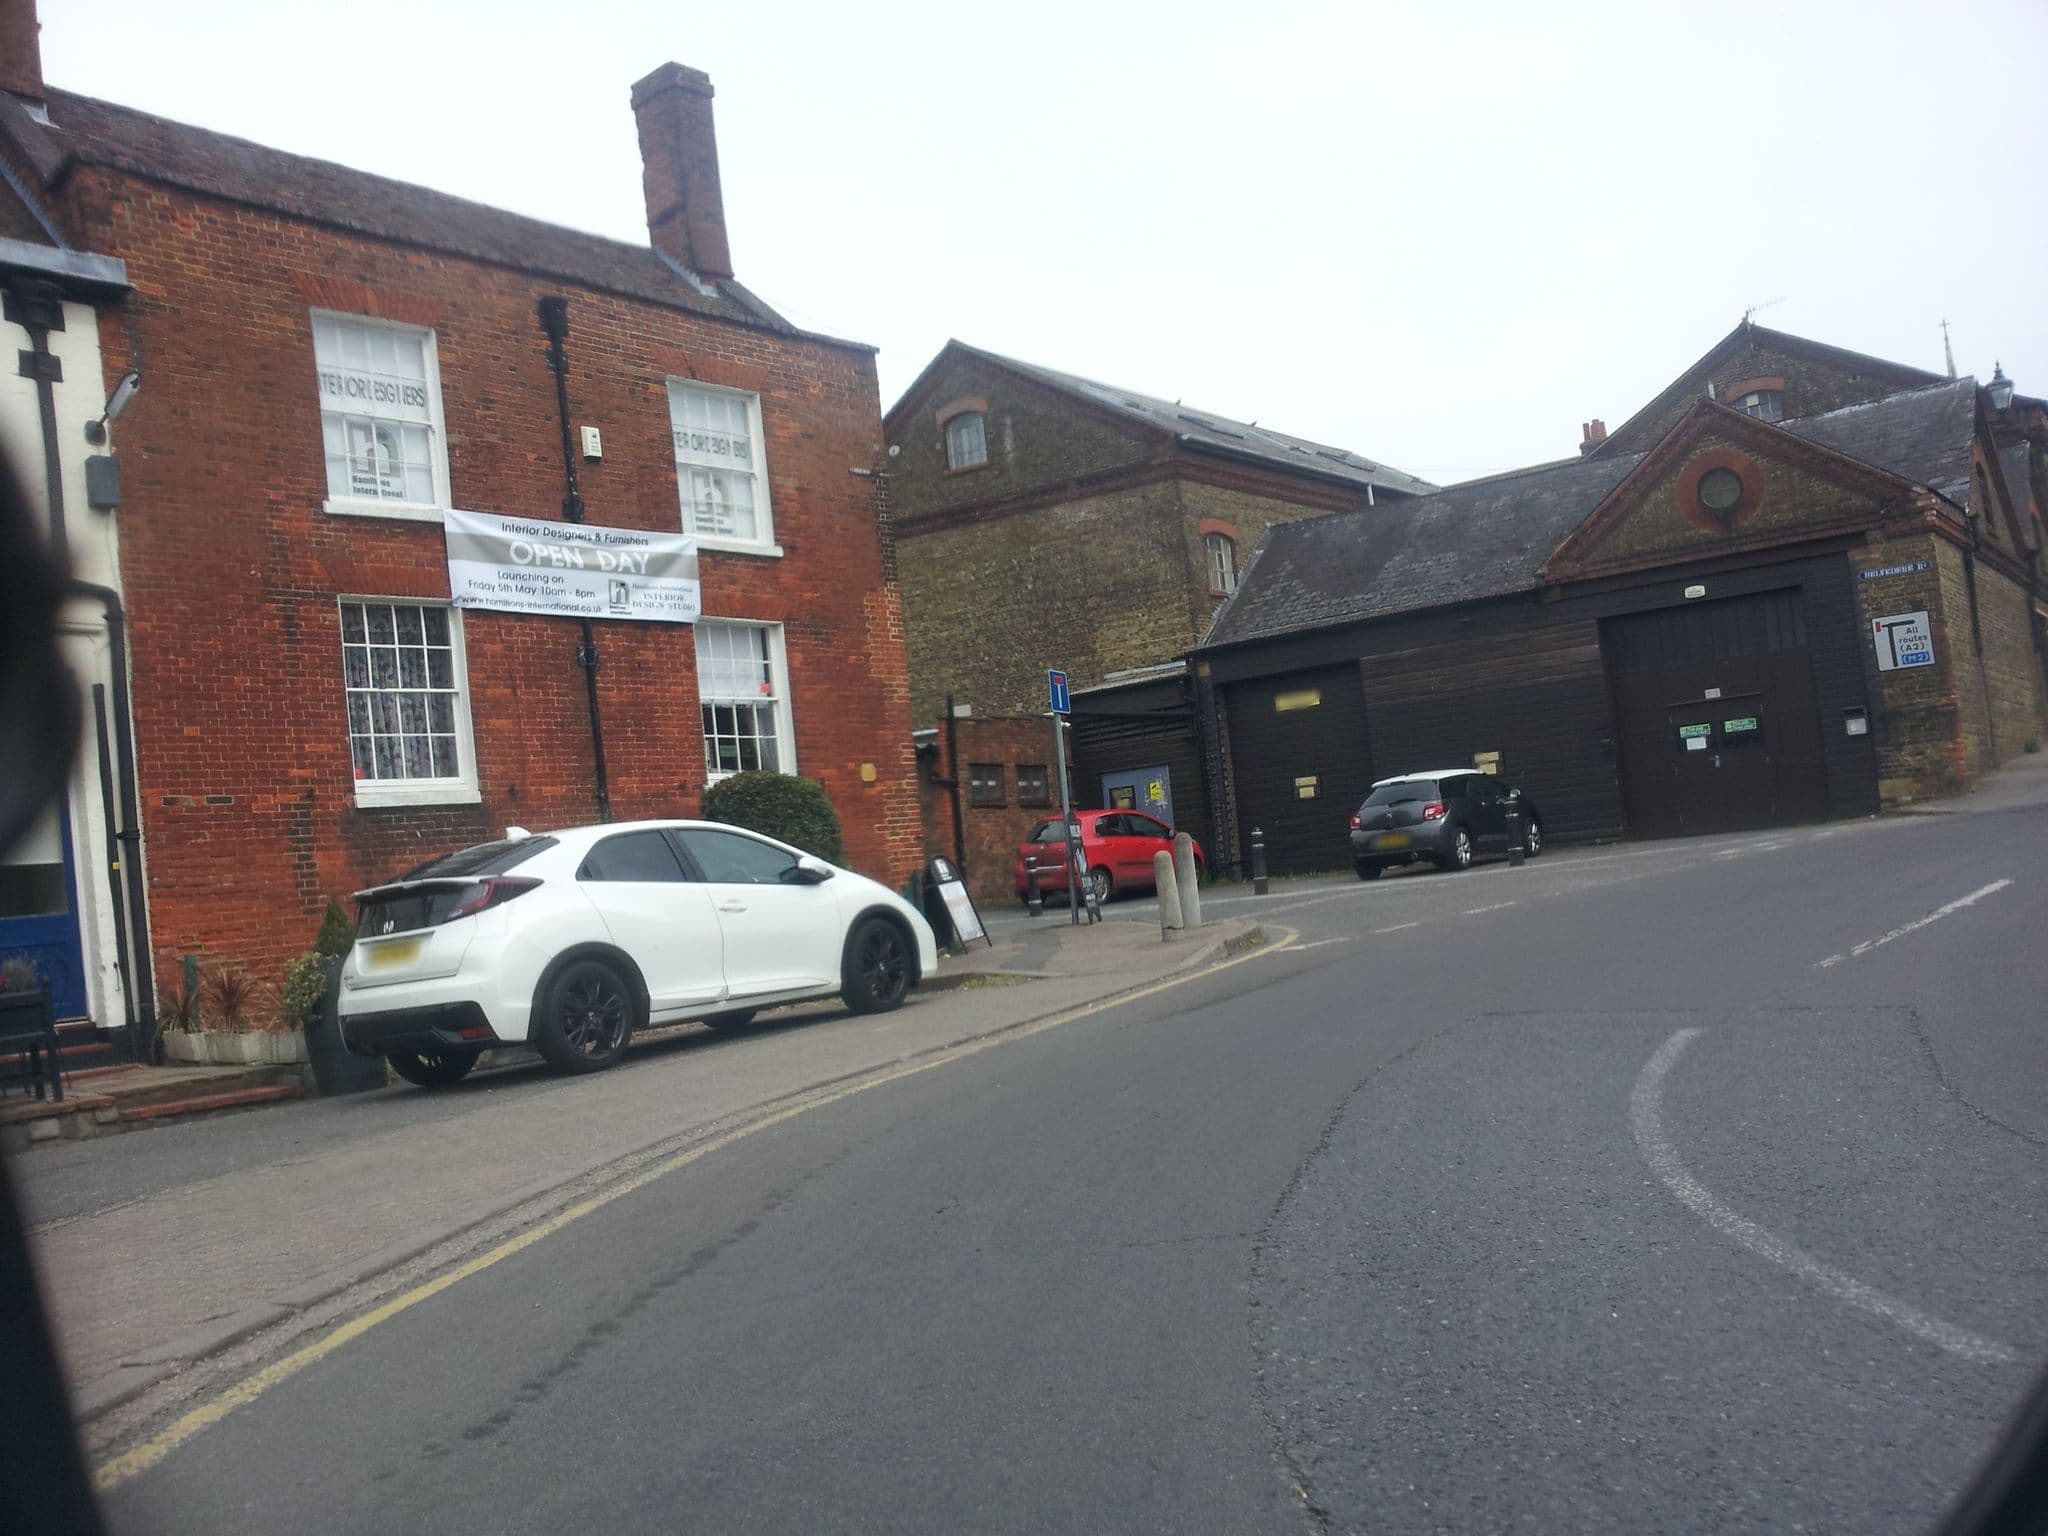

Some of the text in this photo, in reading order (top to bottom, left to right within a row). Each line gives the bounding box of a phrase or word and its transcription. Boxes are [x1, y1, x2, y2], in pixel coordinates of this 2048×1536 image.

[352, 475, 391, 487] Hamiltns
[353, 486, 403, 498] Interntional
[501, 522, 539, 536] Interior
[542, 527, 593, 543] Designers
[594, 532, 602, 544] &
[509, 540, 650, 574] OPEN DAY
[497, 570, 564, 585] Launching on
[468, 579, 496, 593] Friday
[498, 583, 513, 593] 5th
[515, 585, 537, 596] May
[540, 586, 566, 596] 10am
[574, 588, 595, 599] 8pm
[1906, 626, 1919, 634] All
[1899, 635, 1928, 643] routes
[1900, 642, 1925, 653] (A2)
[1903, 653, 1929, 664] (M2)
